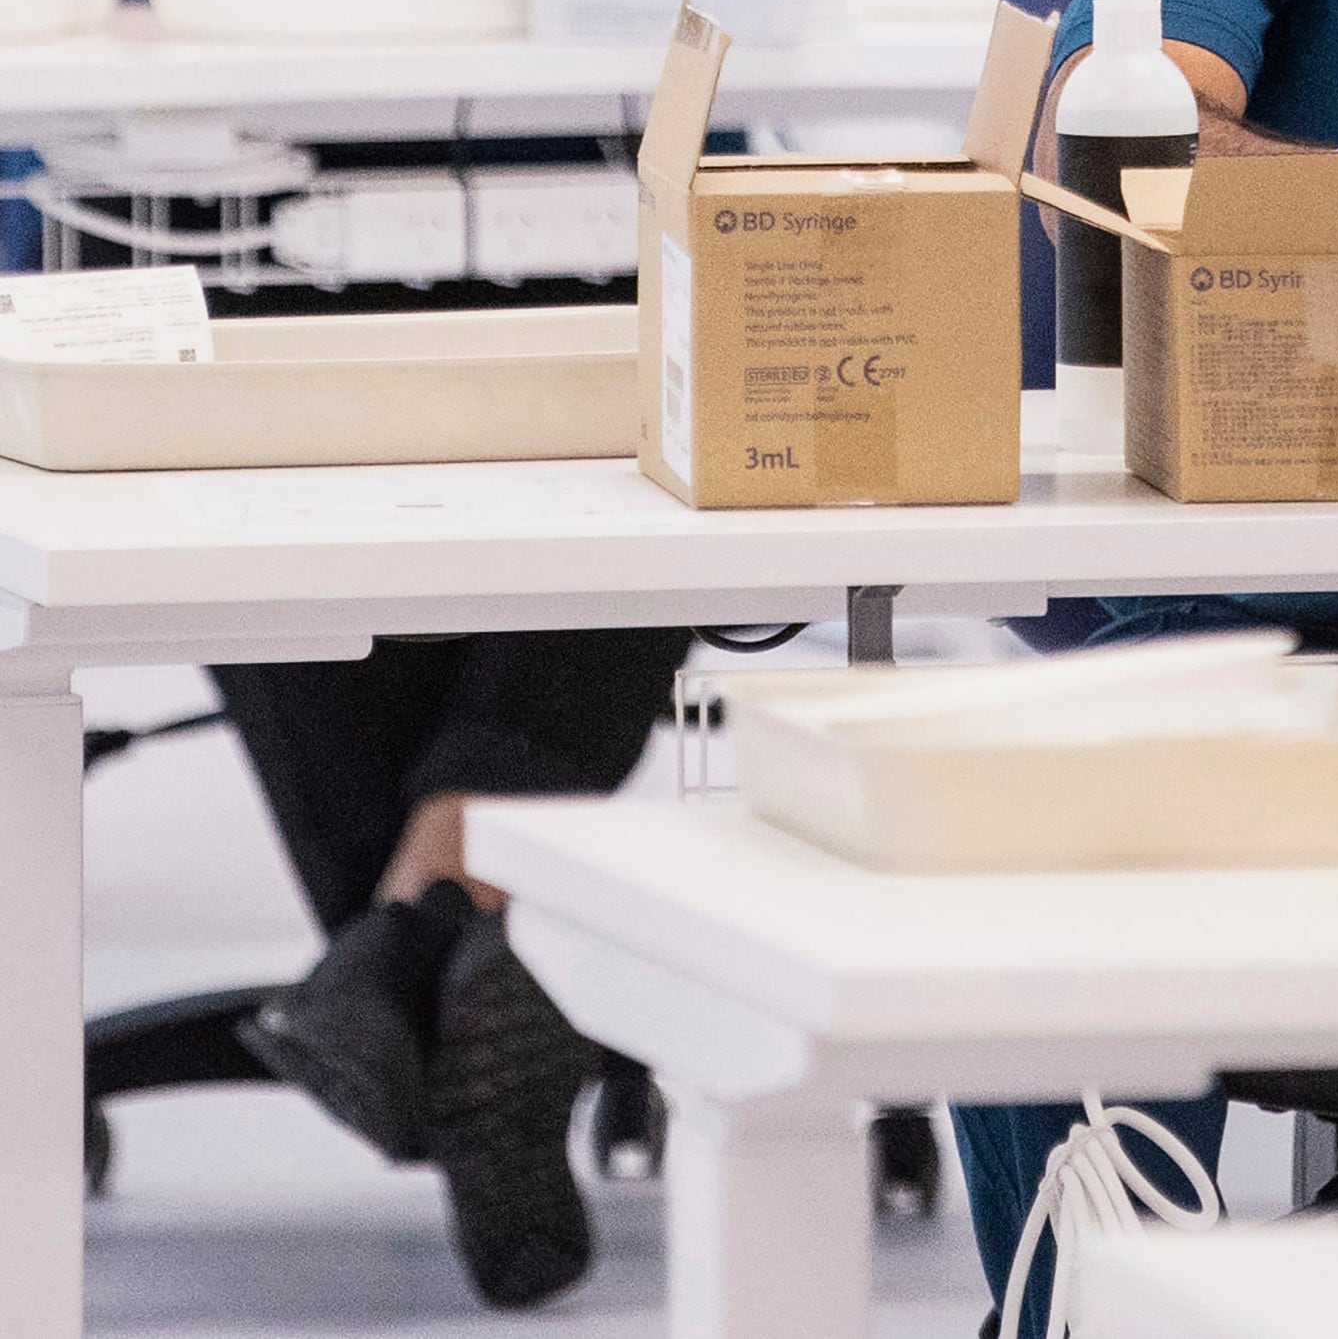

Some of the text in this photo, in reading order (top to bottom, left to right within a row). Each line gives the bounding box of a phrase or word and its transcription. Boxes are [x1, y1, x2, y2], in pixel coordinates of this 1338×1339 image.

[742, 212, 857, 235] BD Syringe
[1219, 269, 1252, 289] BD
[748, 370, 789, 382] STERILE
[745, 446, 800, 470] 3mL
